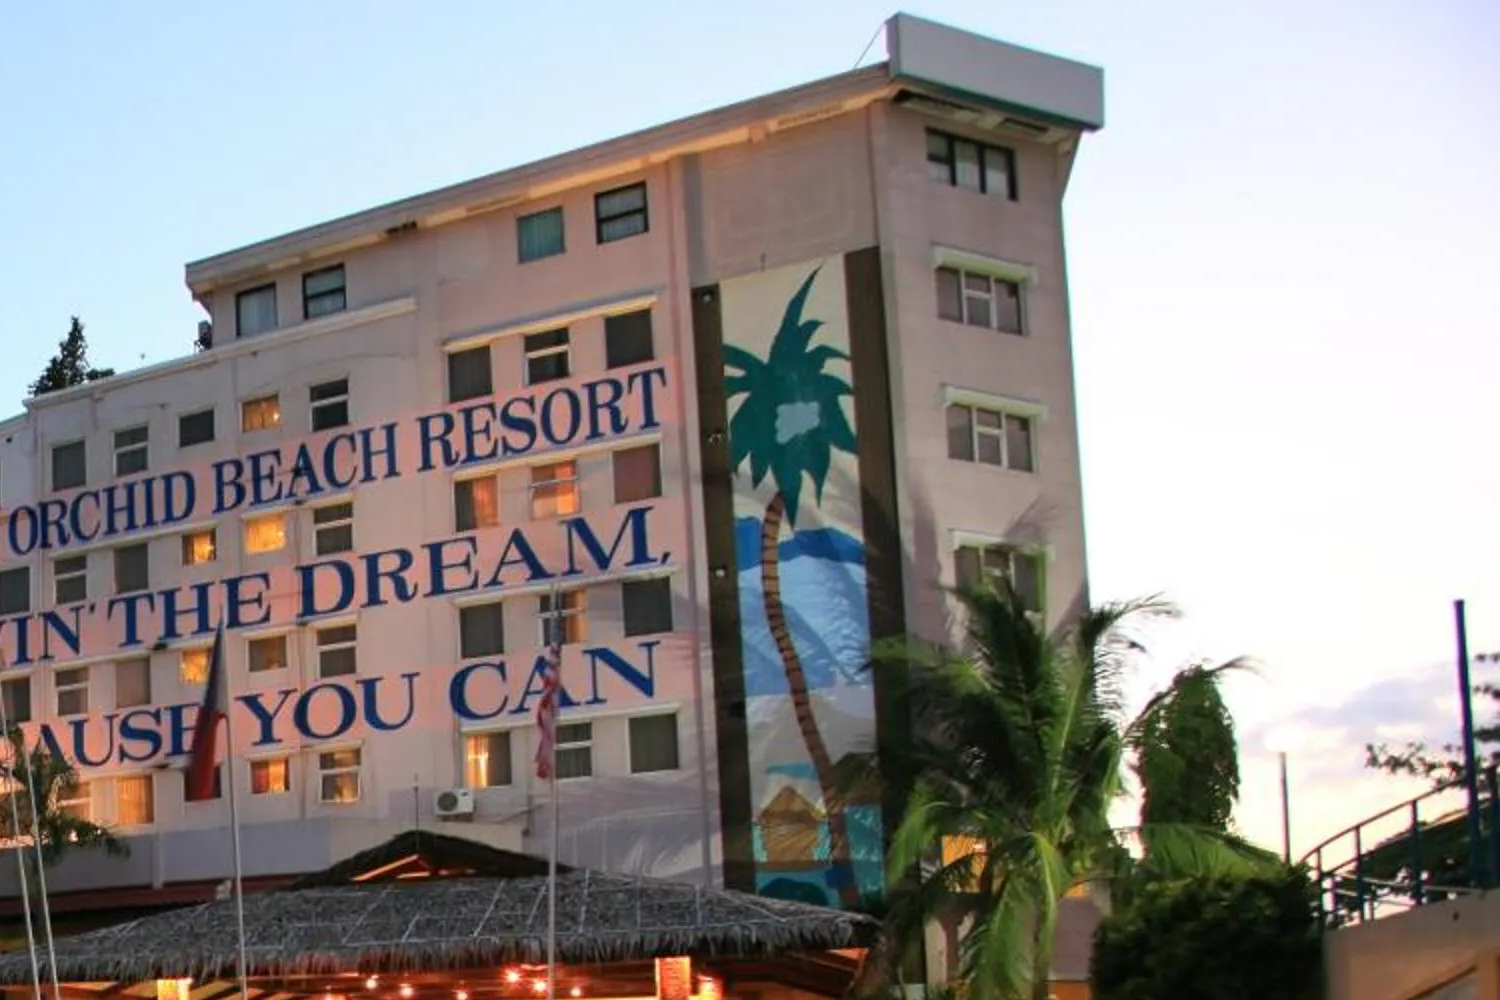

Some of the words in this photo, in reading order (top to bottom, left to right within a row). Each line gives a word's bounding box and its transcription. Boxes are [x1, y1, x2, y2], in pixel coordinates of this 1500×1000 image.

[7, 471, 197, 555] ORCHID
[212, 422, 401, 514] BEACH
[416, 367, 667, 473] RESORT
[106, 573, 271, 647] THE
[296, 506, 671, 626] DREAM,
[234, 672, 420, 746] YOU
[449, 641, 660, 720] CAN
